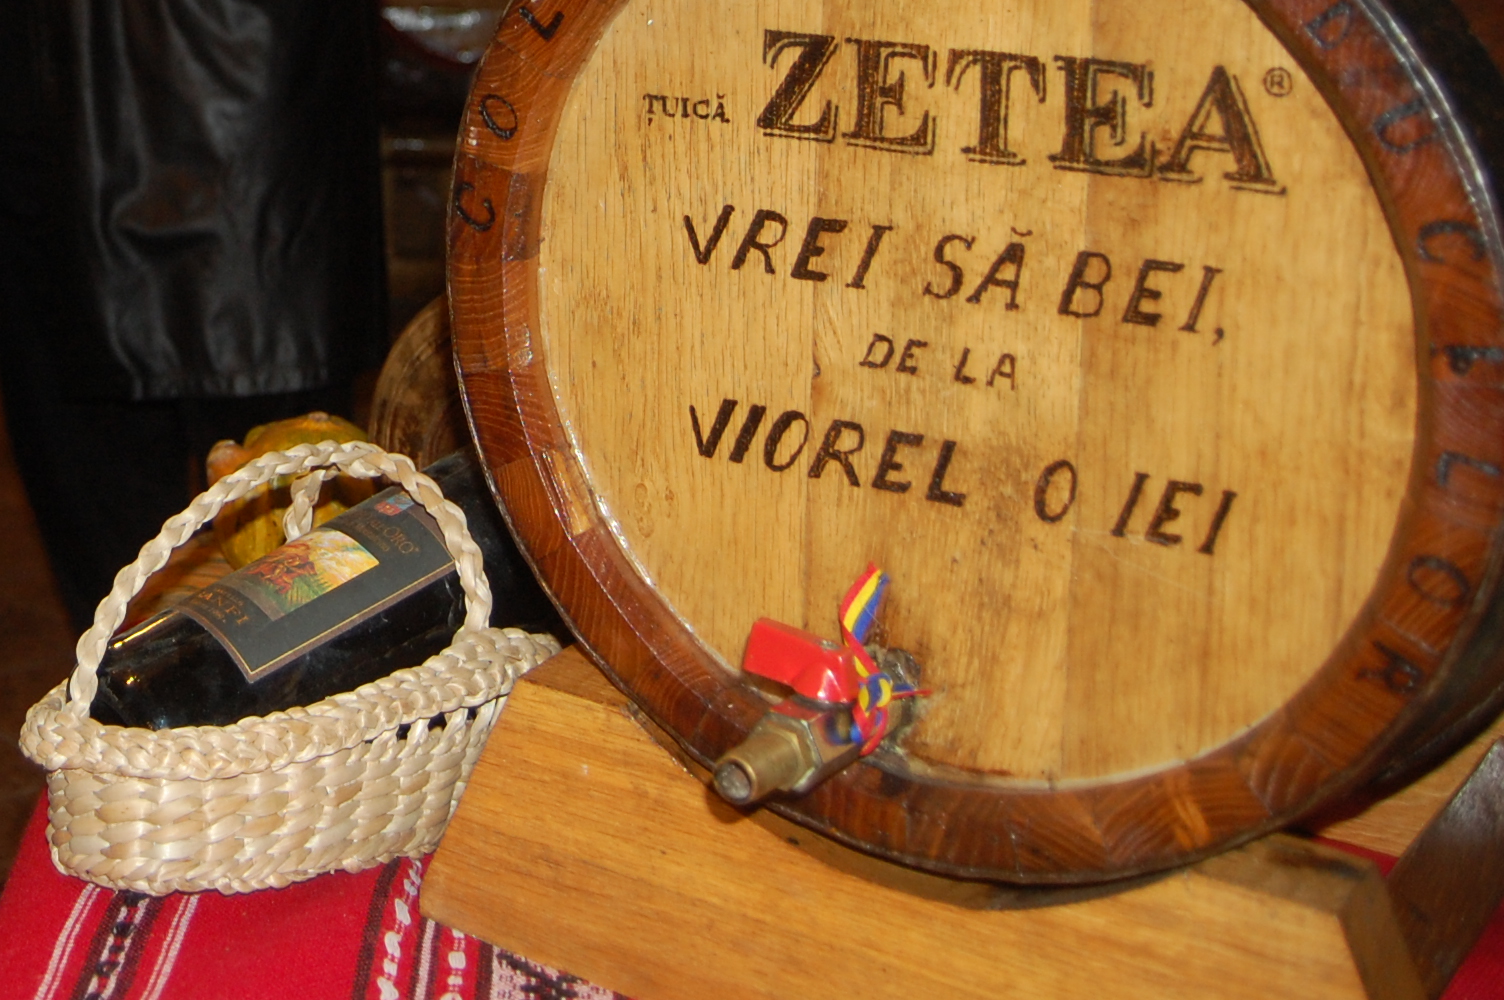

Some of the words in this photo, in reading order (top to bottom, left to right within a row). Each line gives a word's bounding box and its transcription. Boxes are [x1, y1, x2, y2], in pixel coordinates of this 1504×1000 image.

[758, 28, 1287, 195] ZETEA
[683, 204, 894, 290] VREI
[923, 228, 1033, 312] SĂ
[858, 334, 929, 377] DE
[953, 348, 1019, 390] LA
[690, 399, 969, 508] VIOREL
[1034, 458, 1078, 524] O
[1112, 470, 1239, 557] IEI
